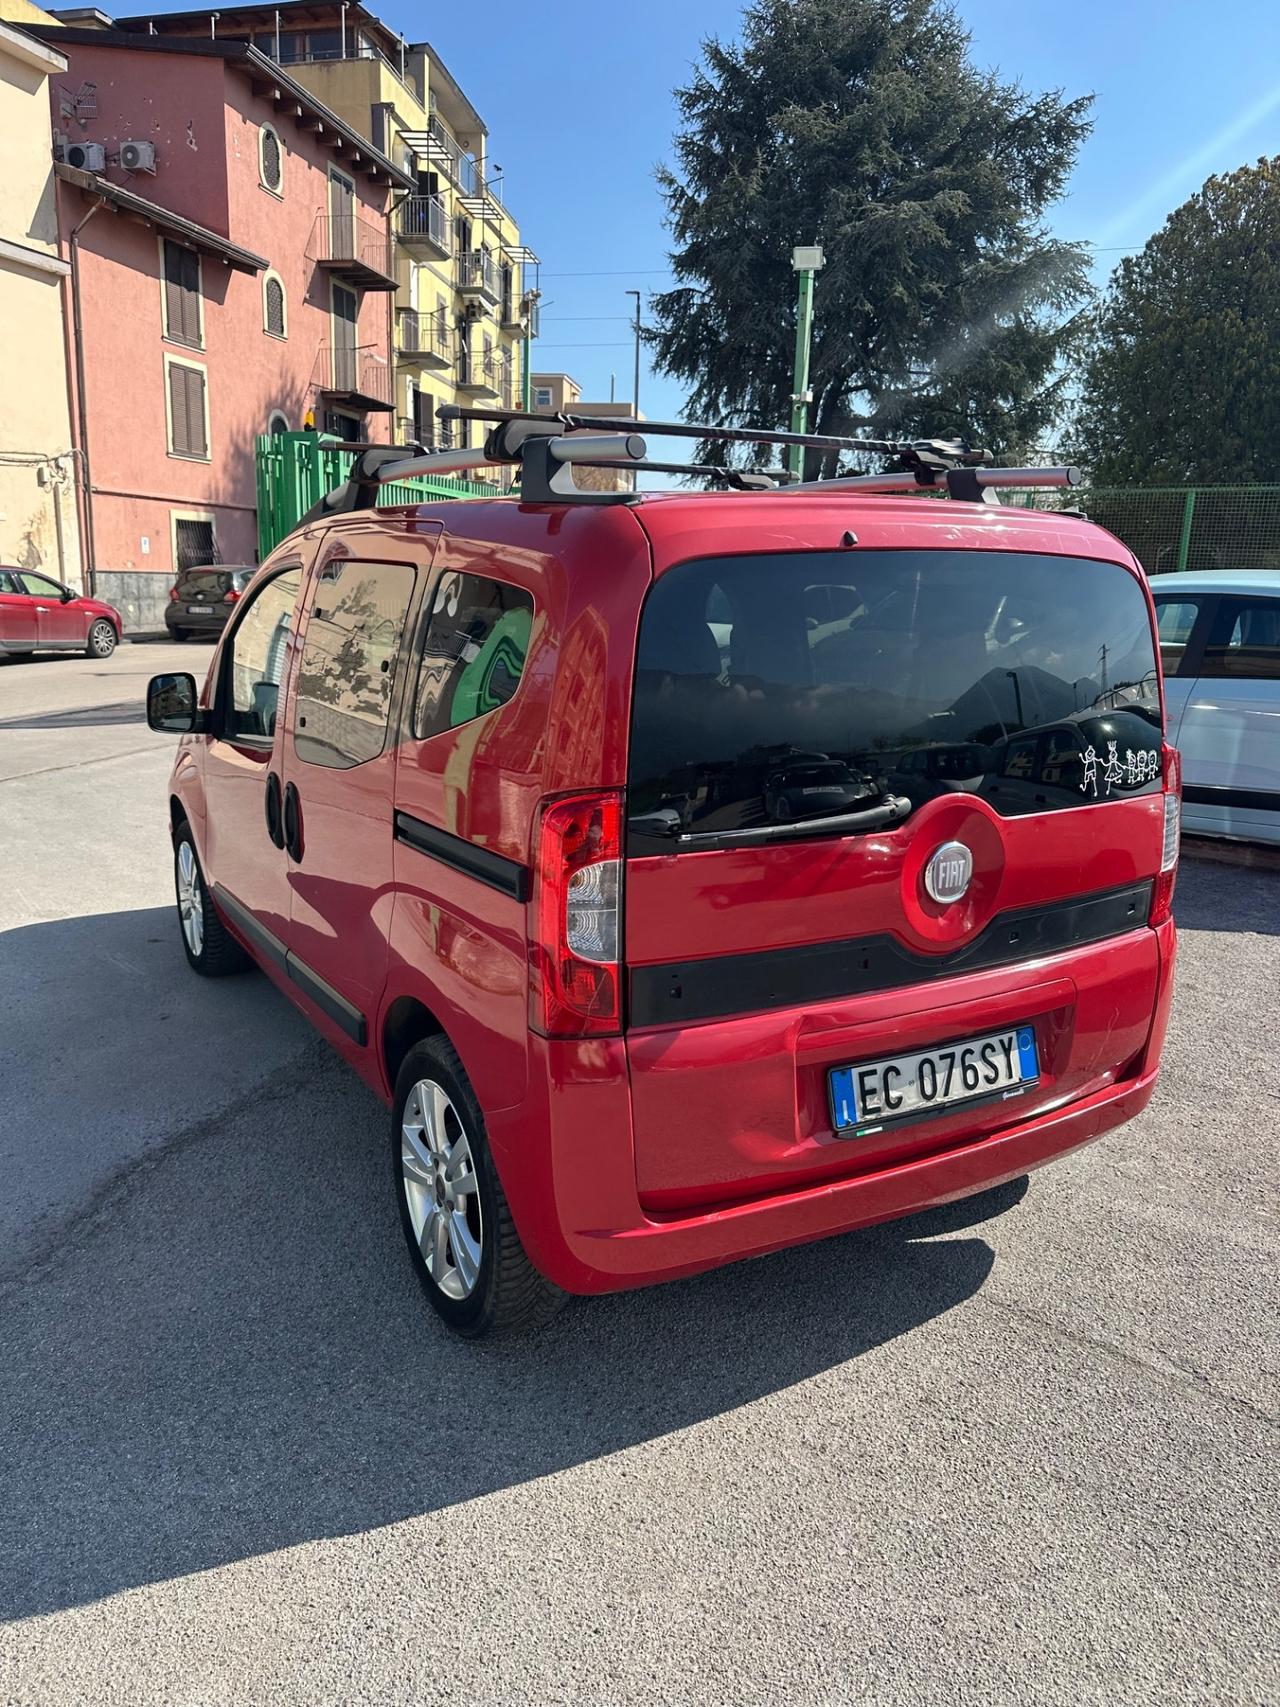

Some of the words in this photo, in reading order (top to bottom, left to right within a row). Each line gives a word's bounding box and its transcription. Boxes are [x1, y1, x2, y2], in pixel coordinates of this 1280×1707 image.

[938, 860, 966, 889] FIAT
[858, 1065, 903, 1116] EC
[918, 1036, 1014, 1101] 076SY
